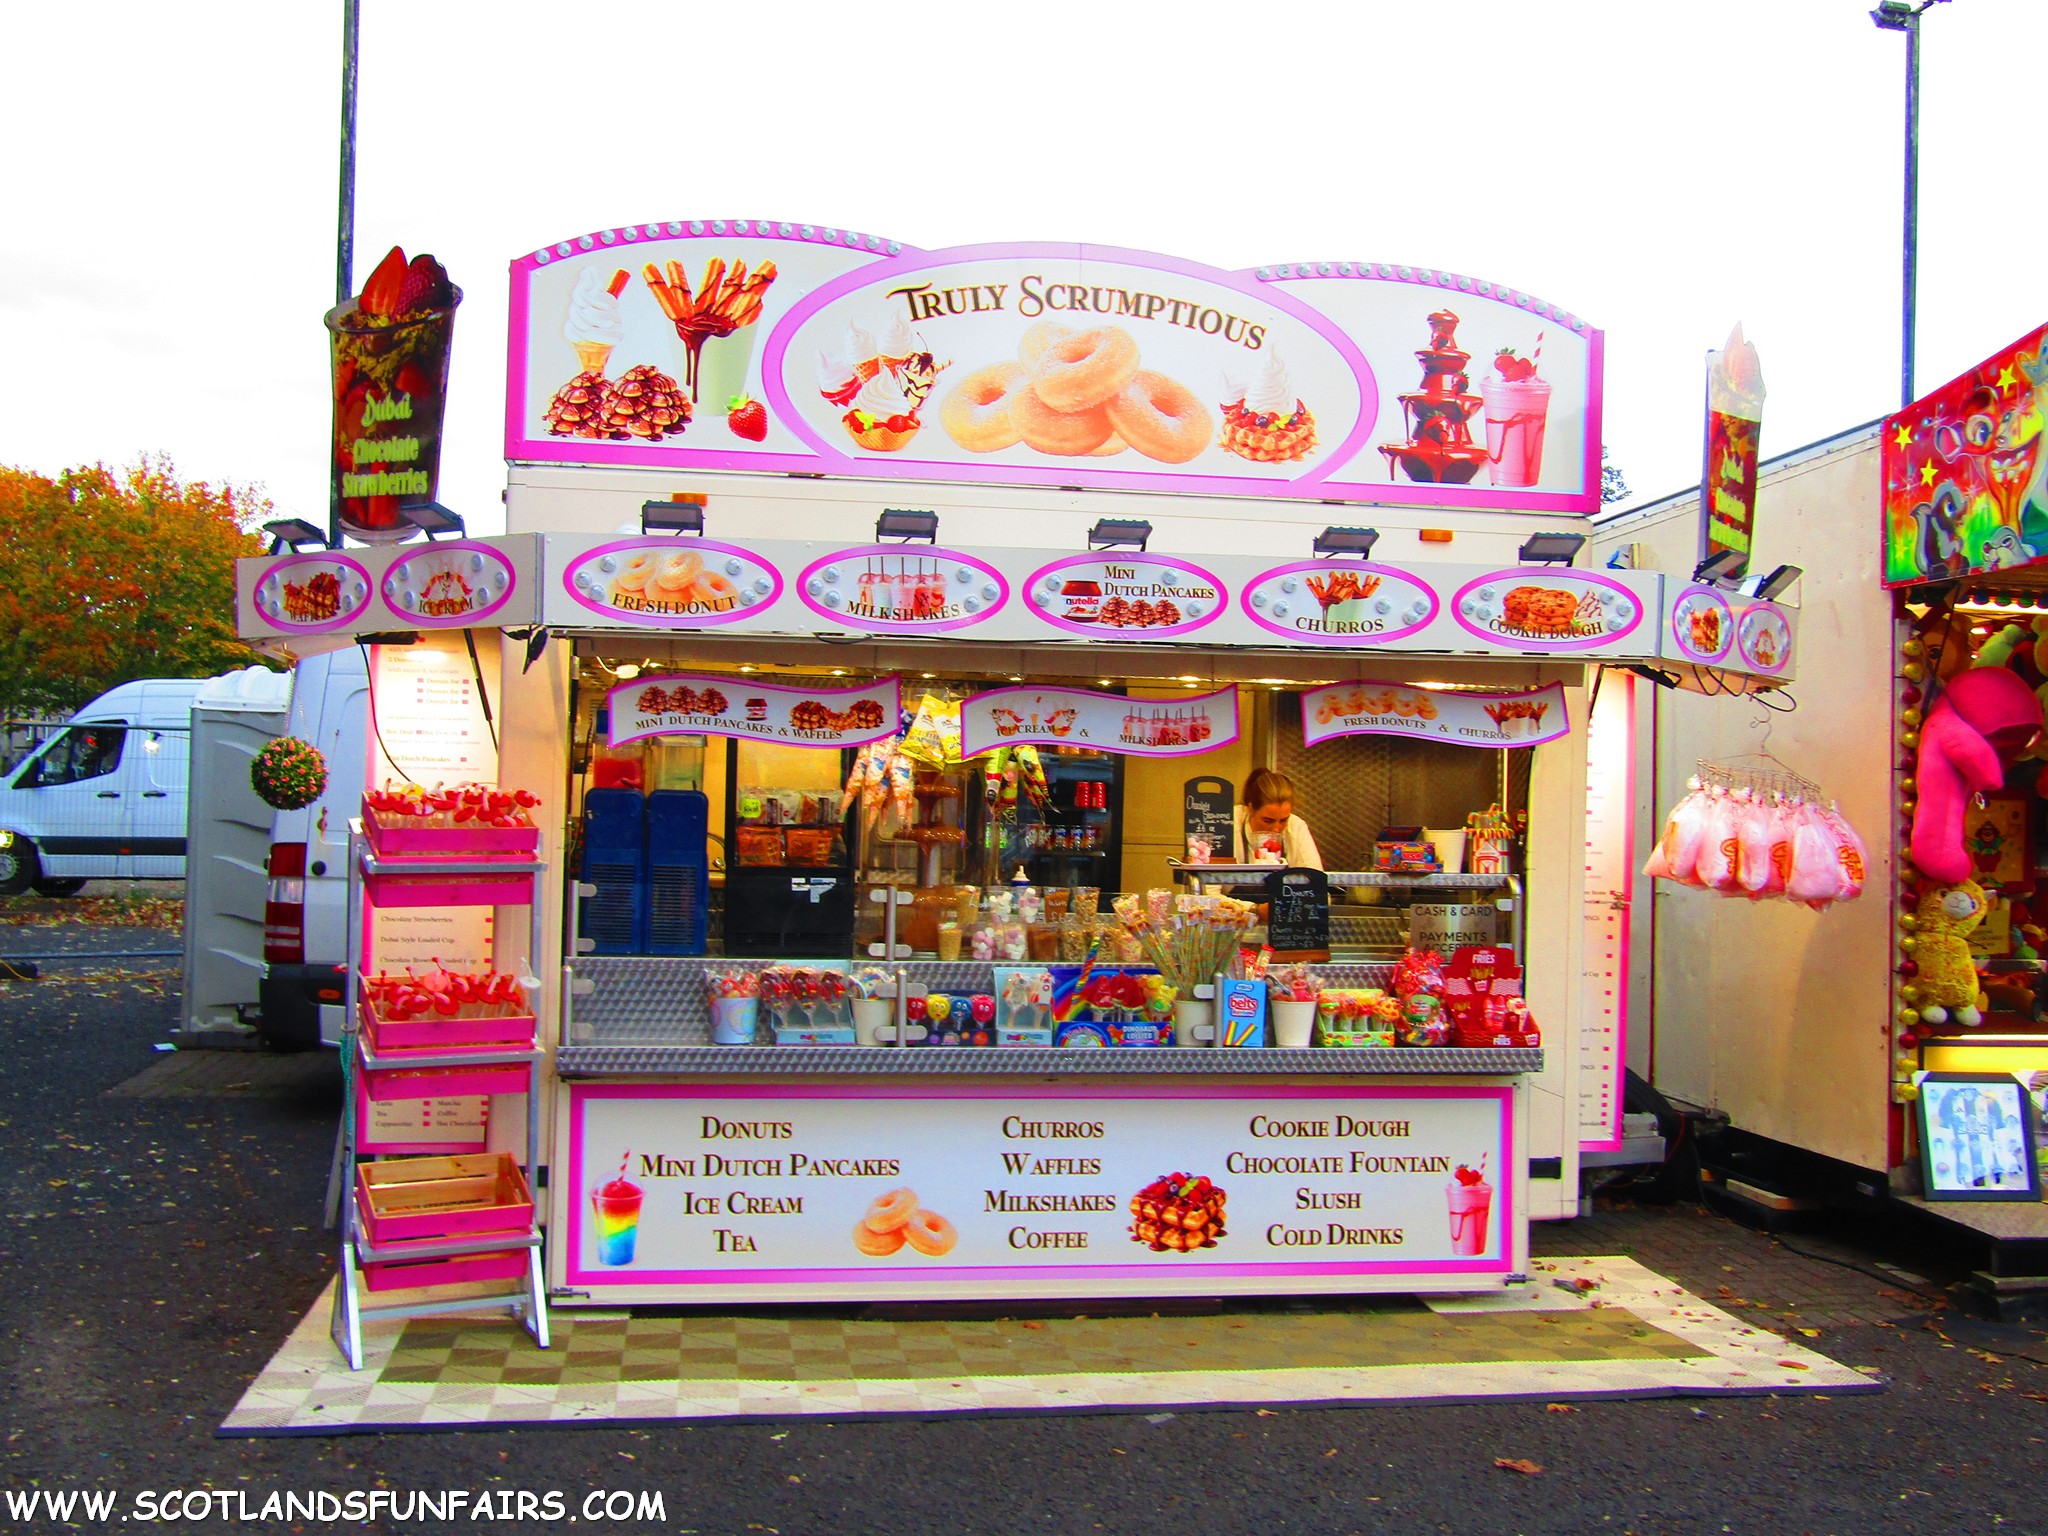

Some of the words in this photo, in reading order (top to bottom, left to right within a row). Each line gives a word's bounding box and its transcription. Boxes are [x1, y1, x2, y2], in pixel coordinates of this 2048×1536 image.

[886, 282, 1008, 322] TRULY
[1018, 274, 1268, 351] SCRUMPTIOUS
[361, 389, 413, 427] Dubai
[354, 435, 420, 464] Chocolate
[342, 468, 428, 498] Strawberries
[1104, 565, 1135, 580] MINI
[1065, 597, 1100, 606] nutella
[1104, 582, 1148, 597] DUTCH
[1152, 584, 1215, 599] PANCAKES
[419, 598, 439, 614] ICE
[612, 593, 669, 614] FRESH
[675, 595, 737, 615] DONUT
[846, 600, 961, 621] MILKSHAKES
[1296, 616, 1384, 634] CHURROS
[1489, 618, 1546, 640] COOKIE
[1550, 621, 1603, 640] DOUGH
[635, 717, 663, 731] MINI
[669, 715, 710, 727] DUTCH
[714, 717, 773, 735] PANCAKES
[778, 727, 788, 737] &
[793, 728, 842, 740] WAFFLES
[996, 724, 1015, 737] ICE
[1018, 724, 1056, 735] CREAM
[1079, 729, 1090, 738] &
[1119, 733, 1188, 746] MILKSHAKES
[1343, 717, 1378, 728] FRESH
[1381, 717, 1426, 730] DONUTS
[1438, 724, 1448, 733] &
[1458, 727, 1511, 740] CHURROS
[1415, 906, 1447, 917] CASH
[1450, 906, 1457, 917] &
[1460, 906, 1492, 917] CARD
[1420, 931, 1487, 942] PAYMENTS
[1472, 954, 1495, 964] FRIES
[1231, 997, 1257, 1010] belts
[700, 1116, 793, 1139] DONUTS
[1002, 1116, 1104, 1139] CHURROS
[1250, 1115, 1329, 1138] COOKIE
[1335, 1115, 1410, 1138] DOUGH
[640, 1154, 695, 1178] MINI
[702, 1153, 782, 1177] DUTCH
[789, 1153, 900, 1176] PANCAKES
[1001, 1153, 1101, 1176] WAFFLES
[1226, 1152, 1343, 1174] CHOCOLATE
[1349, 1151, 1450, 1173] FOUNTAIN
[683, 1191, 720, 1215] ICE
[726, 1191, 803, 1215] CREAM
[984, 1190, 1116, 1212] MILKSHAKES
[1296, 1187, 1361, 1210] SLUSH
[713, 1230, 758, 1253] TEA
[1008, 1226, 1088, 1249] COFFEE
[1266, 1224, 1321, 1246] COLD
[1326, 1224, 1403, 1246] DRINKS
